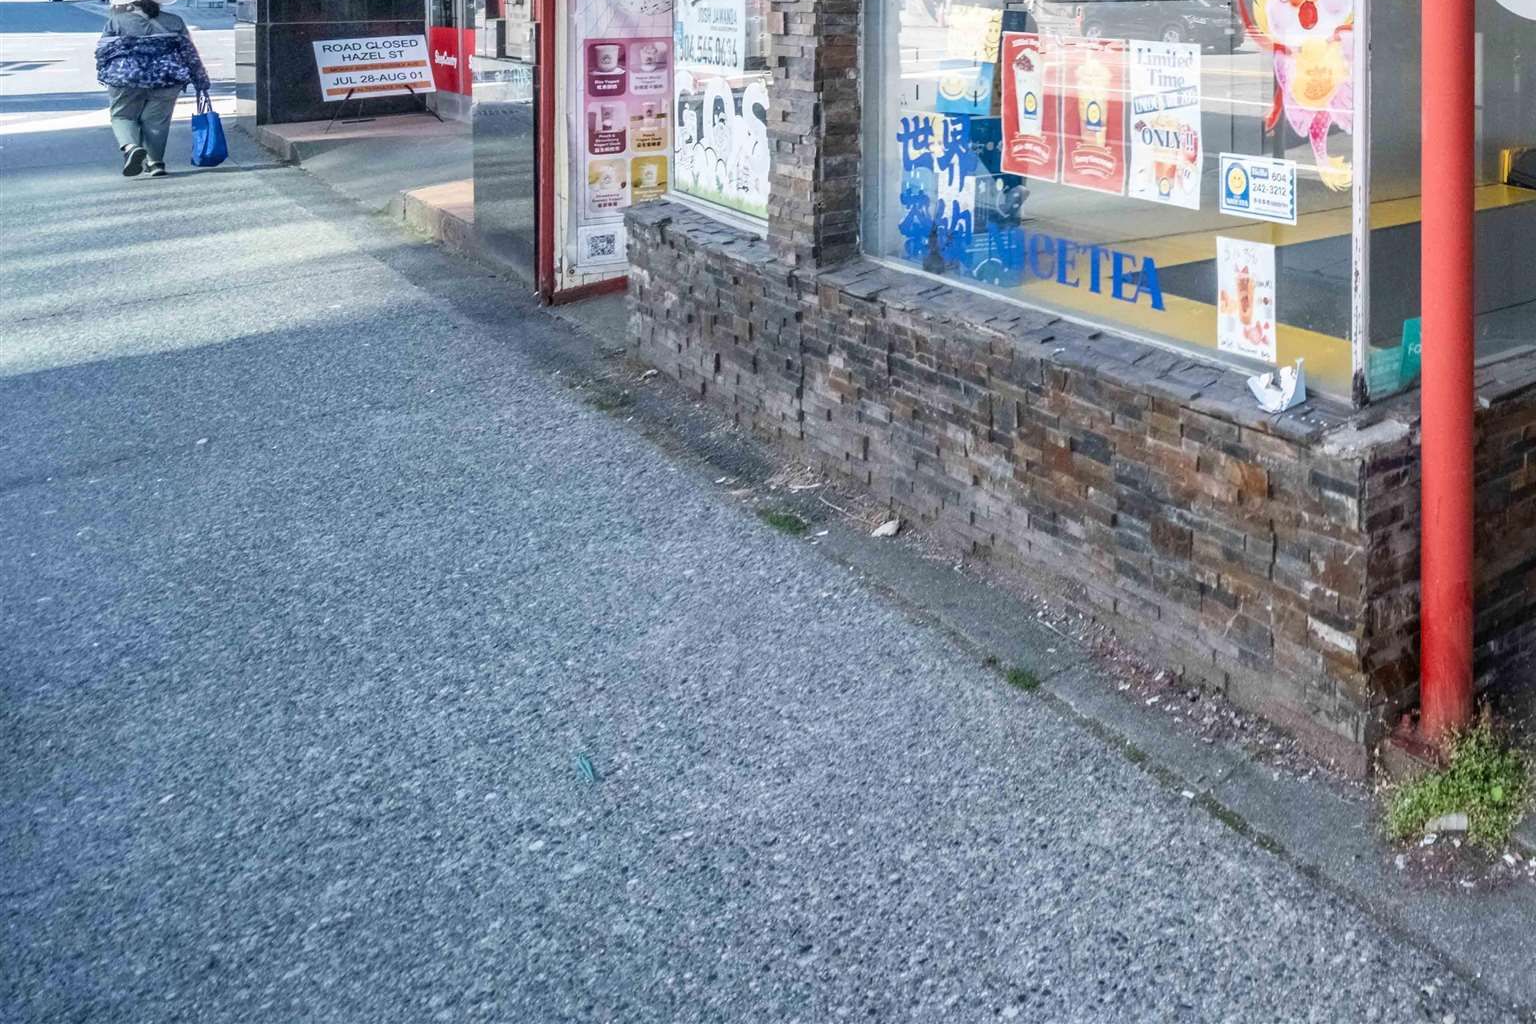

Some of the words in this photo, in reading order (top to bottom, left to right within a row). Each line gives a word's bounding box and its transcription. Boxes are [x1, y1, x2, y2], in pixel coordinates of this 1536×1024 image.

[322, 41, 362, 53] ROAD
[365, 39, 418, 51] CLOSED
[342, 51, 385, 62] HAZEL
[389, 49, 405, 59] ST
[333, 76, 356, 86] JUL
[361, 72, 407, 83] 28-AUG
[409, 70, 424, 80] 01
[1146, 68, 1185, 88] Time
[1142, 127, 1182, 150] ONLY
